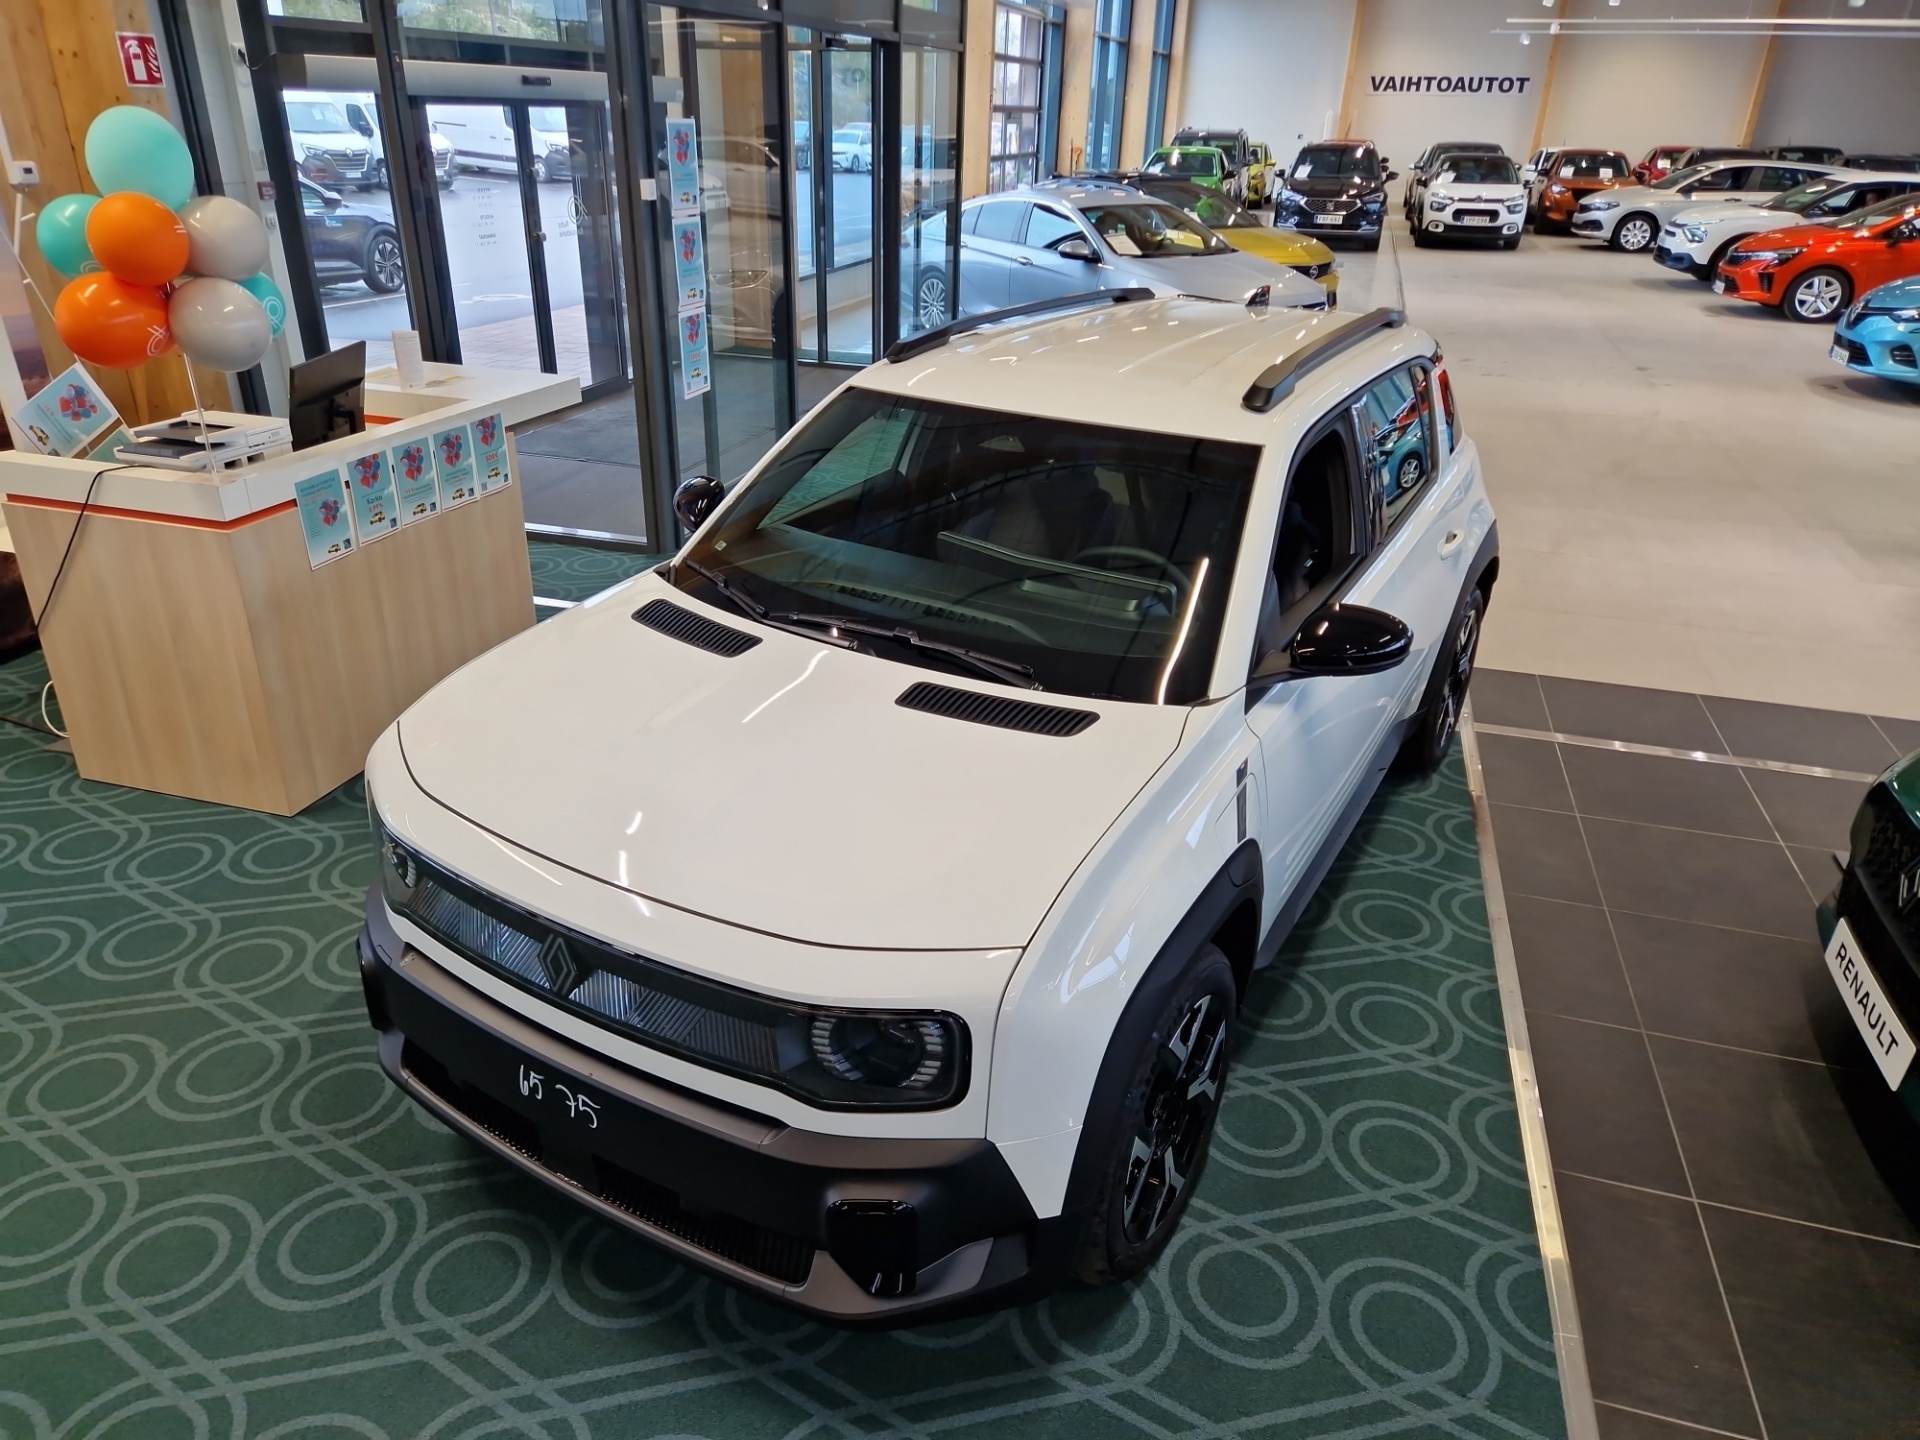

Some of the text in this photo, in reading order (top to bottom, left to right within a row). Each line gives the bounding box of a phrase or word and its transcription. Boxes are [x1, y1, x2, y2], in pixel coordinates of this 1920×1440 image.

[1370, 76, 1530, 94] VAIHTOAUTOT
[366, 494, 382, 505] Korko
[1835, 941, 1899, 1057] RENAULT
[519, 1064, 602, 1129] 65 75
